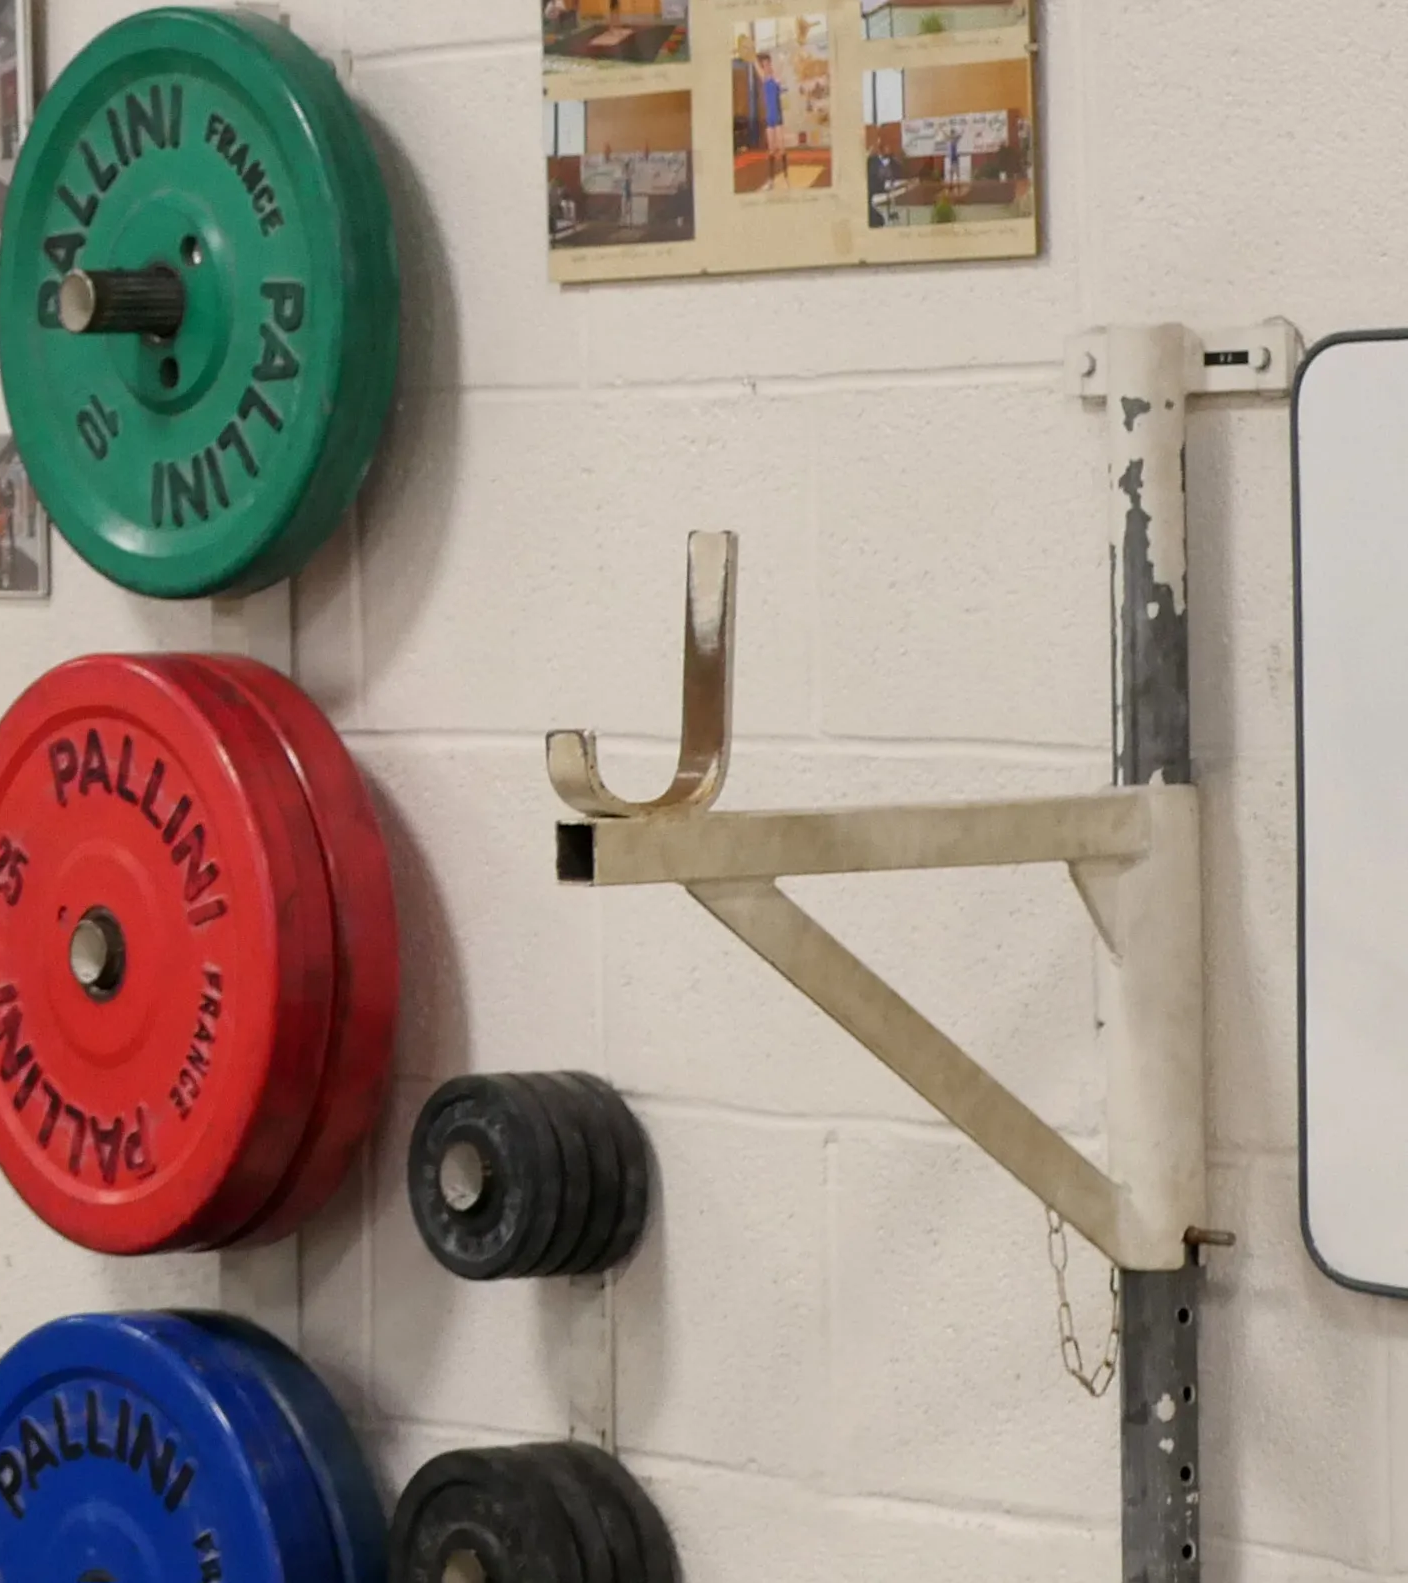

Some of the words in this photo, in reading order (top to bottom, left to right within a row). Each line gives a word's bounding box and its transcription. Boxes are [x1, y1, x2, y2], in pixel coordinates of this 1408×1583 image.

[203, 113, 286, 238] FRANCE
[76, 394, 119, 461] 10
[150, 280, 306, 528] PALLINI
[48, 727, 228, 927] PALLINI
[170, 961, 223, 1121] FRANCE
